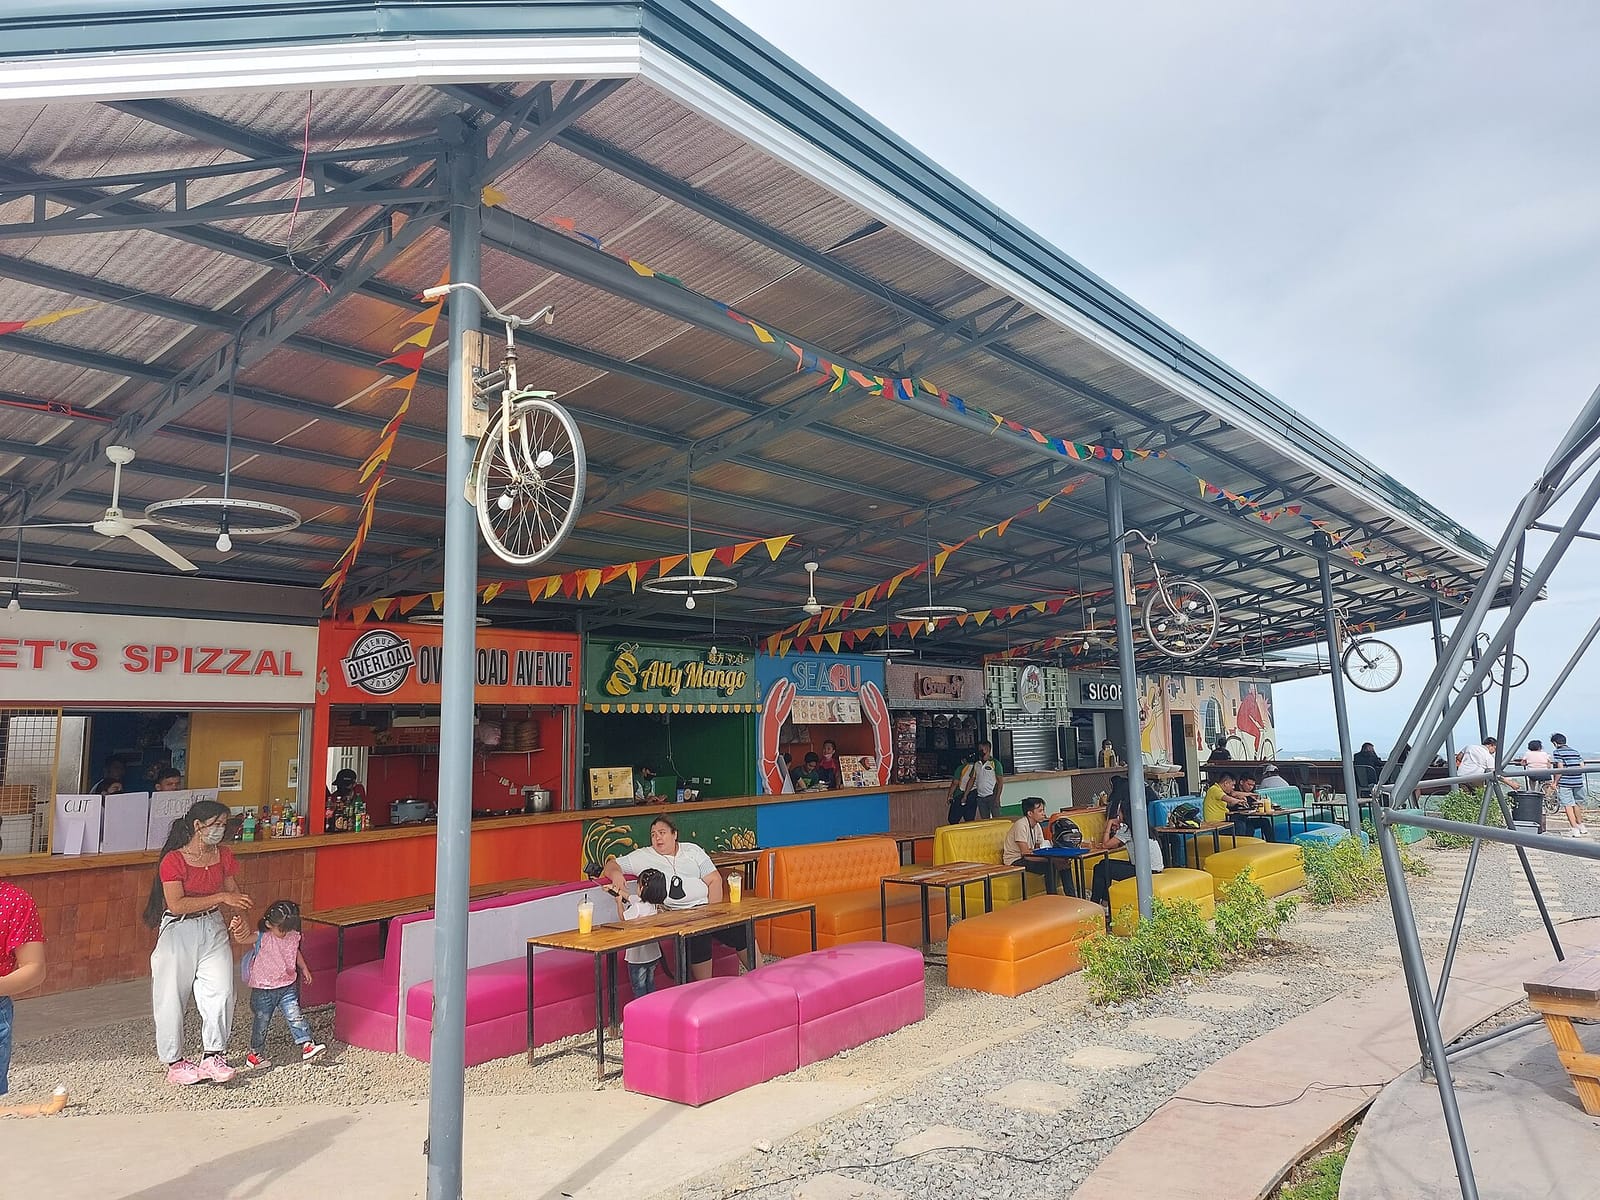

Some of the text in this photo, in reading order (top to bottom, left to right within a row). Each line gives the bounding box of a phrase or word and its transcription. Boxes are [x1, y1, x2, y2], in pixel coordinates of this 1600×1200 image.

[123, 644, 304, 676] SPIZZAL
[348, 645, 413, 680] OVERLOAD
[361, 637, 393, 654] AVENUE
[420, 645, 573, 687] OVOAD AVENUE
[640, 660, 747, 697] Ally Mango
